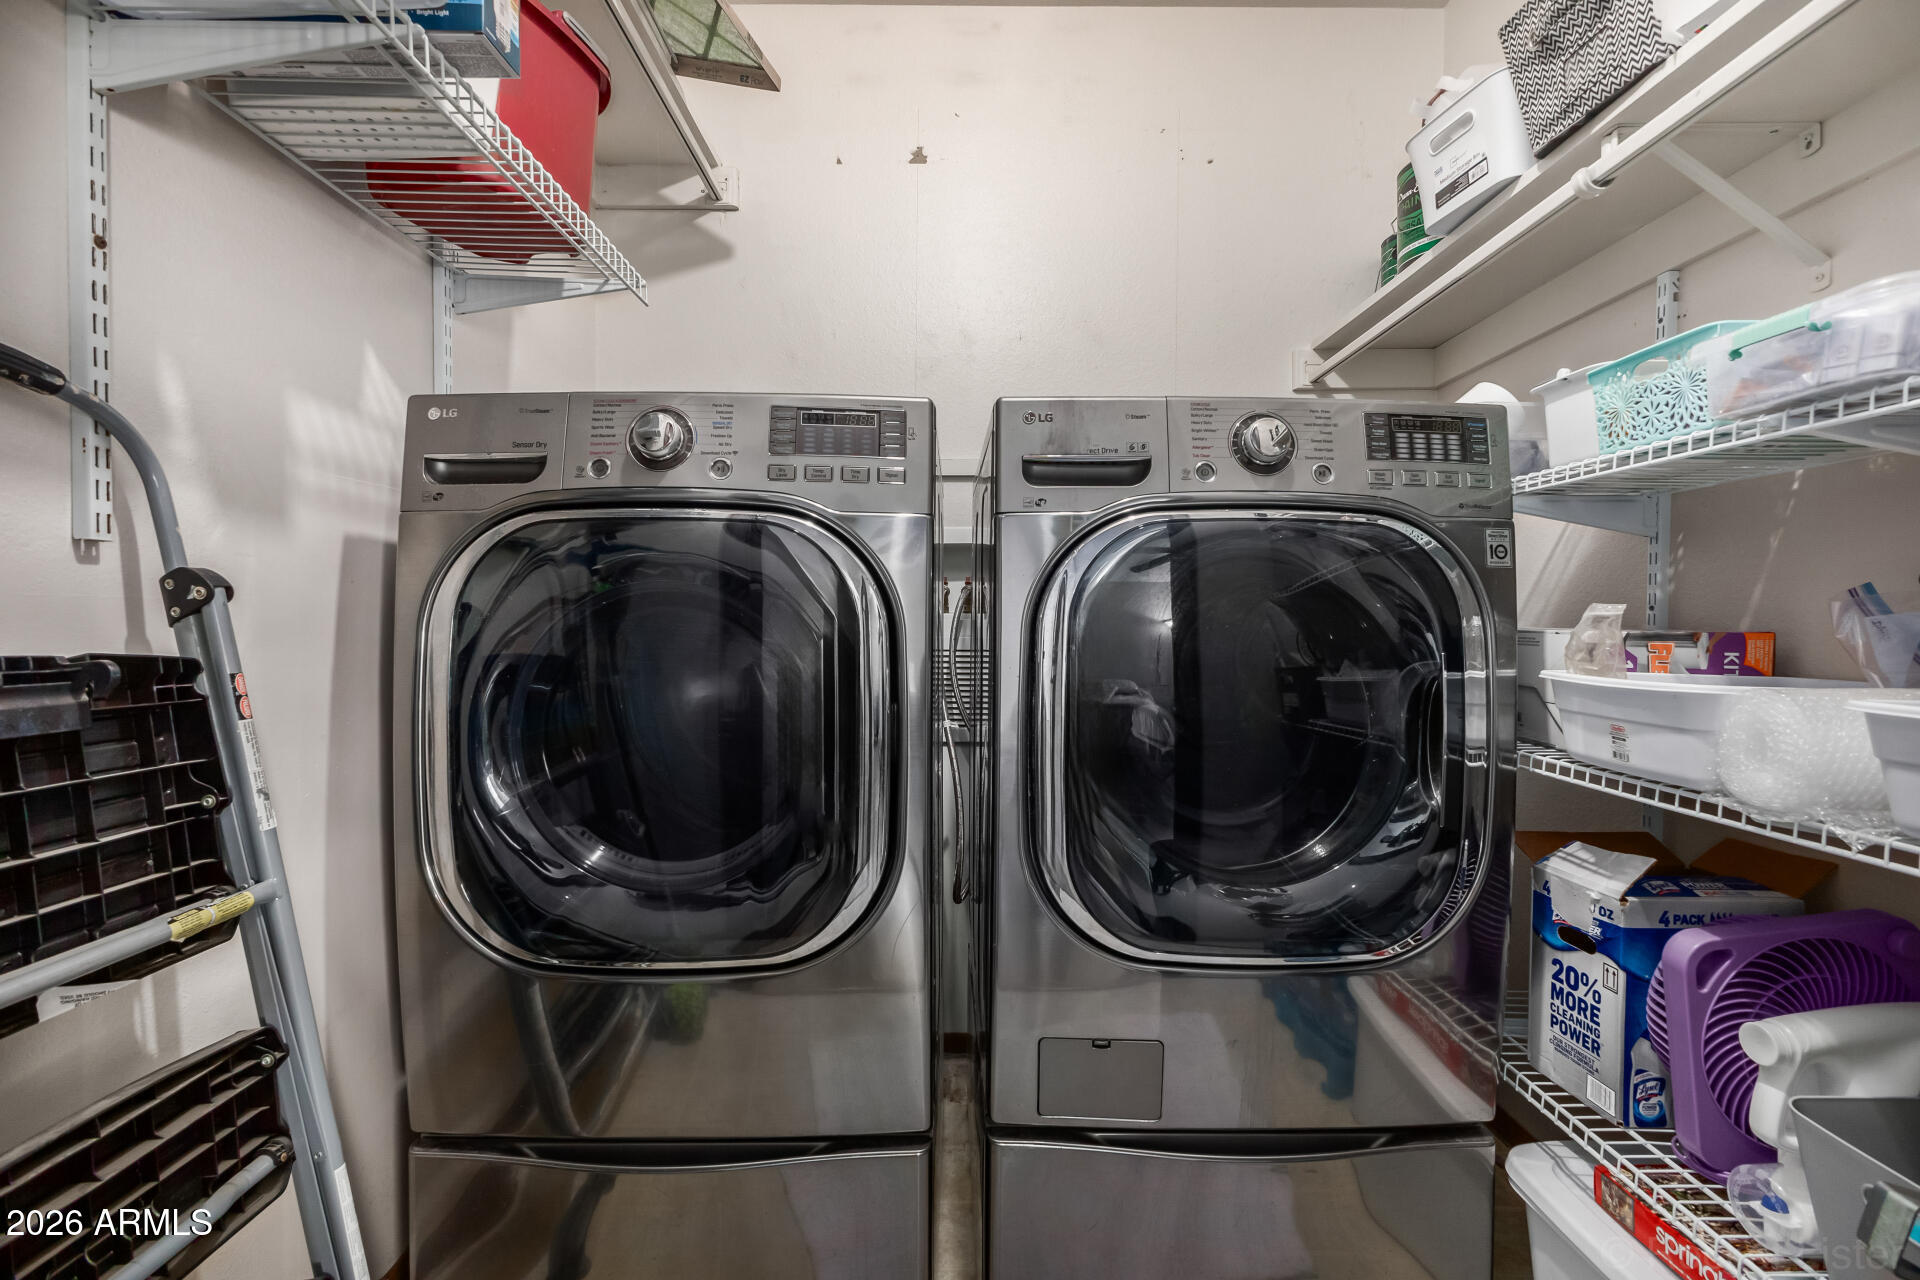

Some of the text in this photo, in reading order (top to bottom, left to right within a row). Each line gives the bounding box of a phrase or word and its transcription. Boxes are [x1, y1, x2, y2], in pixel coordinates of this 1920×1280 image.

[442, 408, 458, 418] LG
[1038, 413, 1053, 423] LG
[536, 441, 547, 449] Dry
[1490, 544, 1508, 559] 10
[1542, 880, 1551, 896] 4
[1599, 906, 1614, 921] OZ
[1659, 910, 1705, 927] 4 PACK
[1552, 958, 1602, 1004] 20%
[1551, 981, 1600, 1027] MORE
[1550, 1002, 1600, 1039] CLEANING
[1550, 1013, 1600, 1058] POWER
[1553, 1035, 1595, 1065] OUR STRONGEST
[1573, 1053, 1599, 1074] FORMULA
[1656, 1226, 1724, 1280] spring
